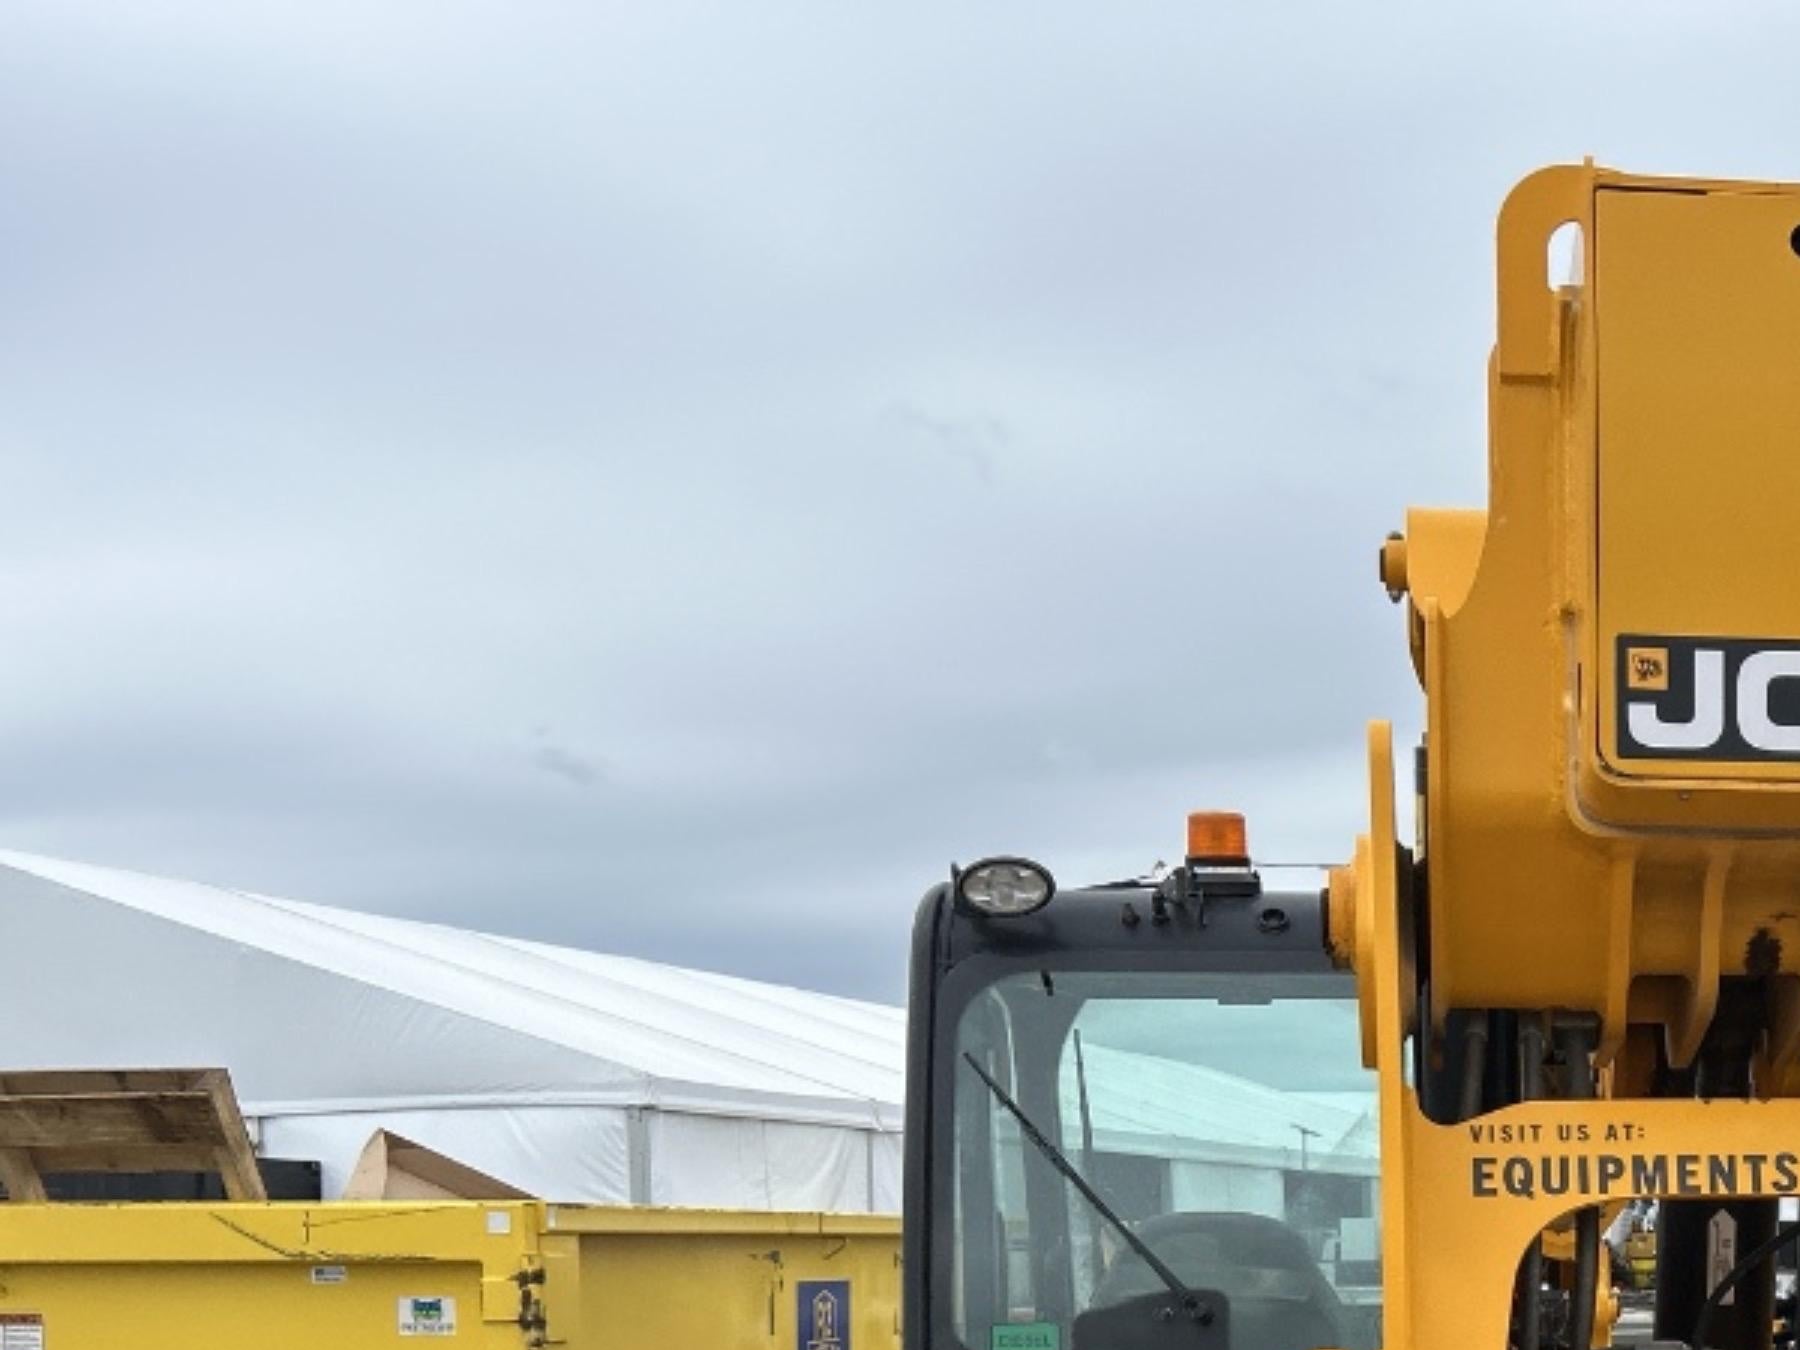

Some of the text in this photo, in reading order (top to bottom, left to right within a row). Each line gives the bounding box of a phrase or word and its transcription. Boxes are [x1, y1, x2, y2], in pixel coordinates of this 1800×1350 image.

[1469, 1124, 1646, 1144] VISIT US AT:
